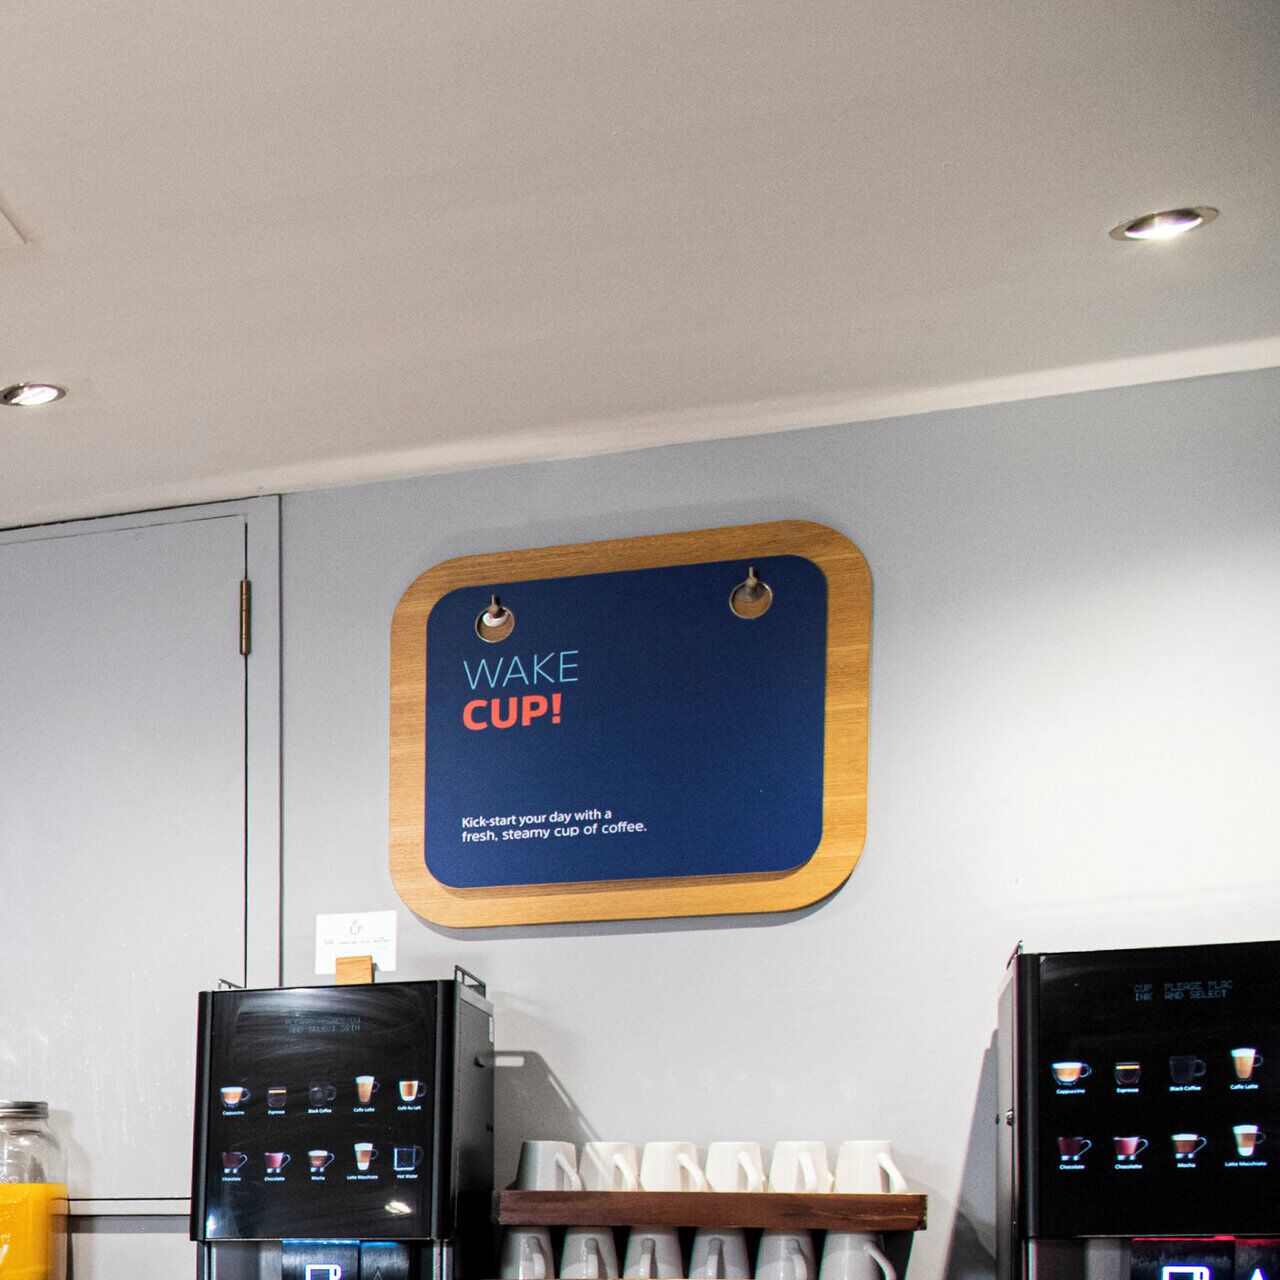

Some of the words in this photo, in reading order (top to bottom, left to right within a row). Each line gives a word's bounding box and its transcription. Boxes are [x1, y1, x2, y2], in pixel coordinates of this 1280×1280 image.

[463, 651, 578, 690] WAKE
[462, 693, 562, 731] CUP!
[461, 815, 517, 828] Kick-start
[519, 813, 546, 827] your
[549, 811, 572, 824] day
[574, 809, 602, 820] with
[604, 810, 612, 819] a
[461, 831, 498, 842] fresh,
[502, 827, 550, 841] steamy
[554, 826, 580, 838] cup
[583, 823, 598, 835] of
[601, 821, 647, 834] coffee.
